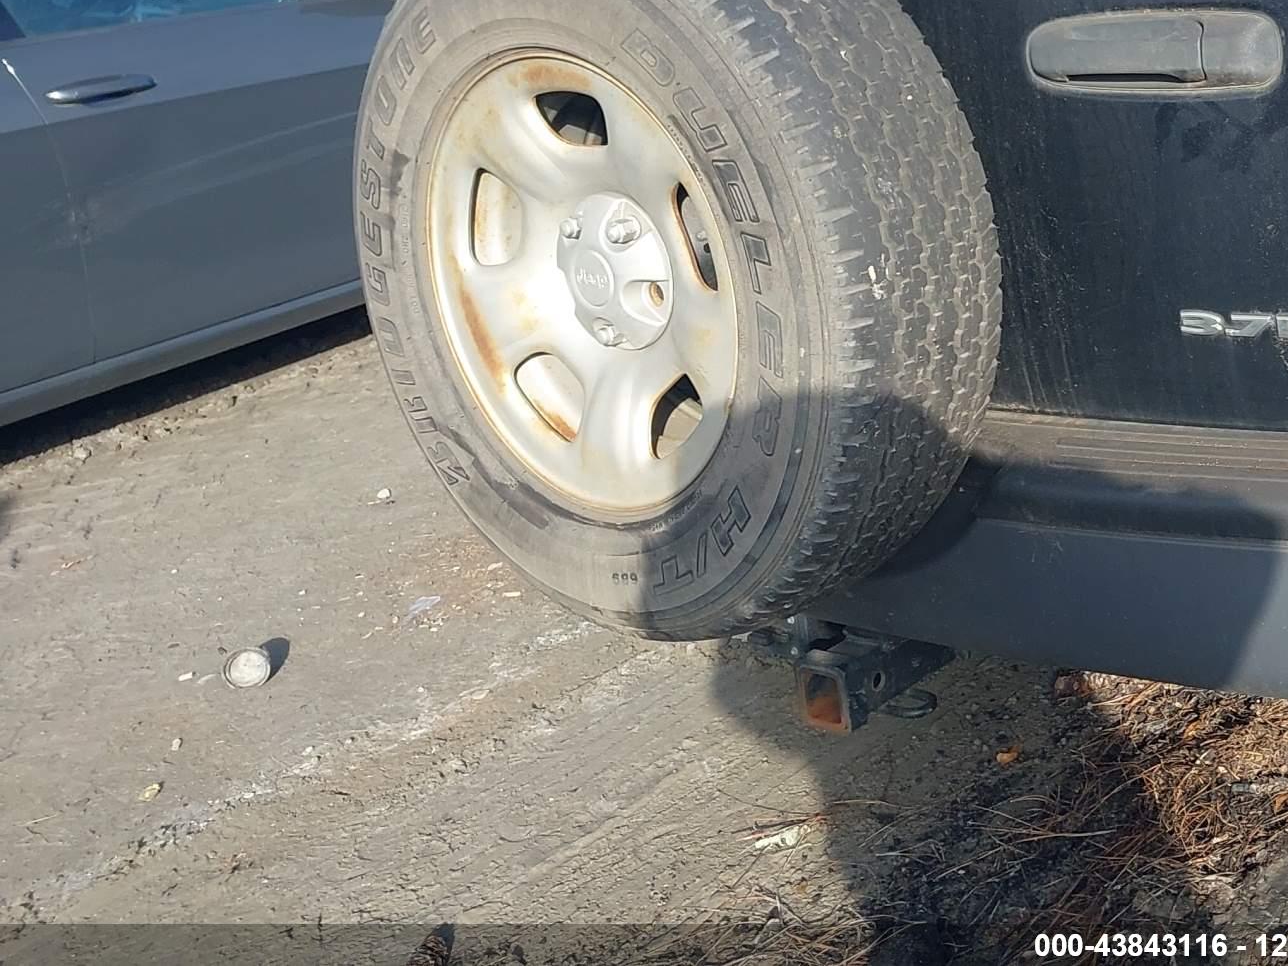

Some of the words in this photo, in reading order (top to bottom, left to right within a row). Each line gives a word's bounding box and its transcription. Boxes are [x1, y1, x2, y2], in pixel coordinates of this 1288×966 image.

[358, 5, 471, 487] BRIDGESTONE
[620, 28, 784, 457] DUELER
[653, 485, 752, 596] H/T
